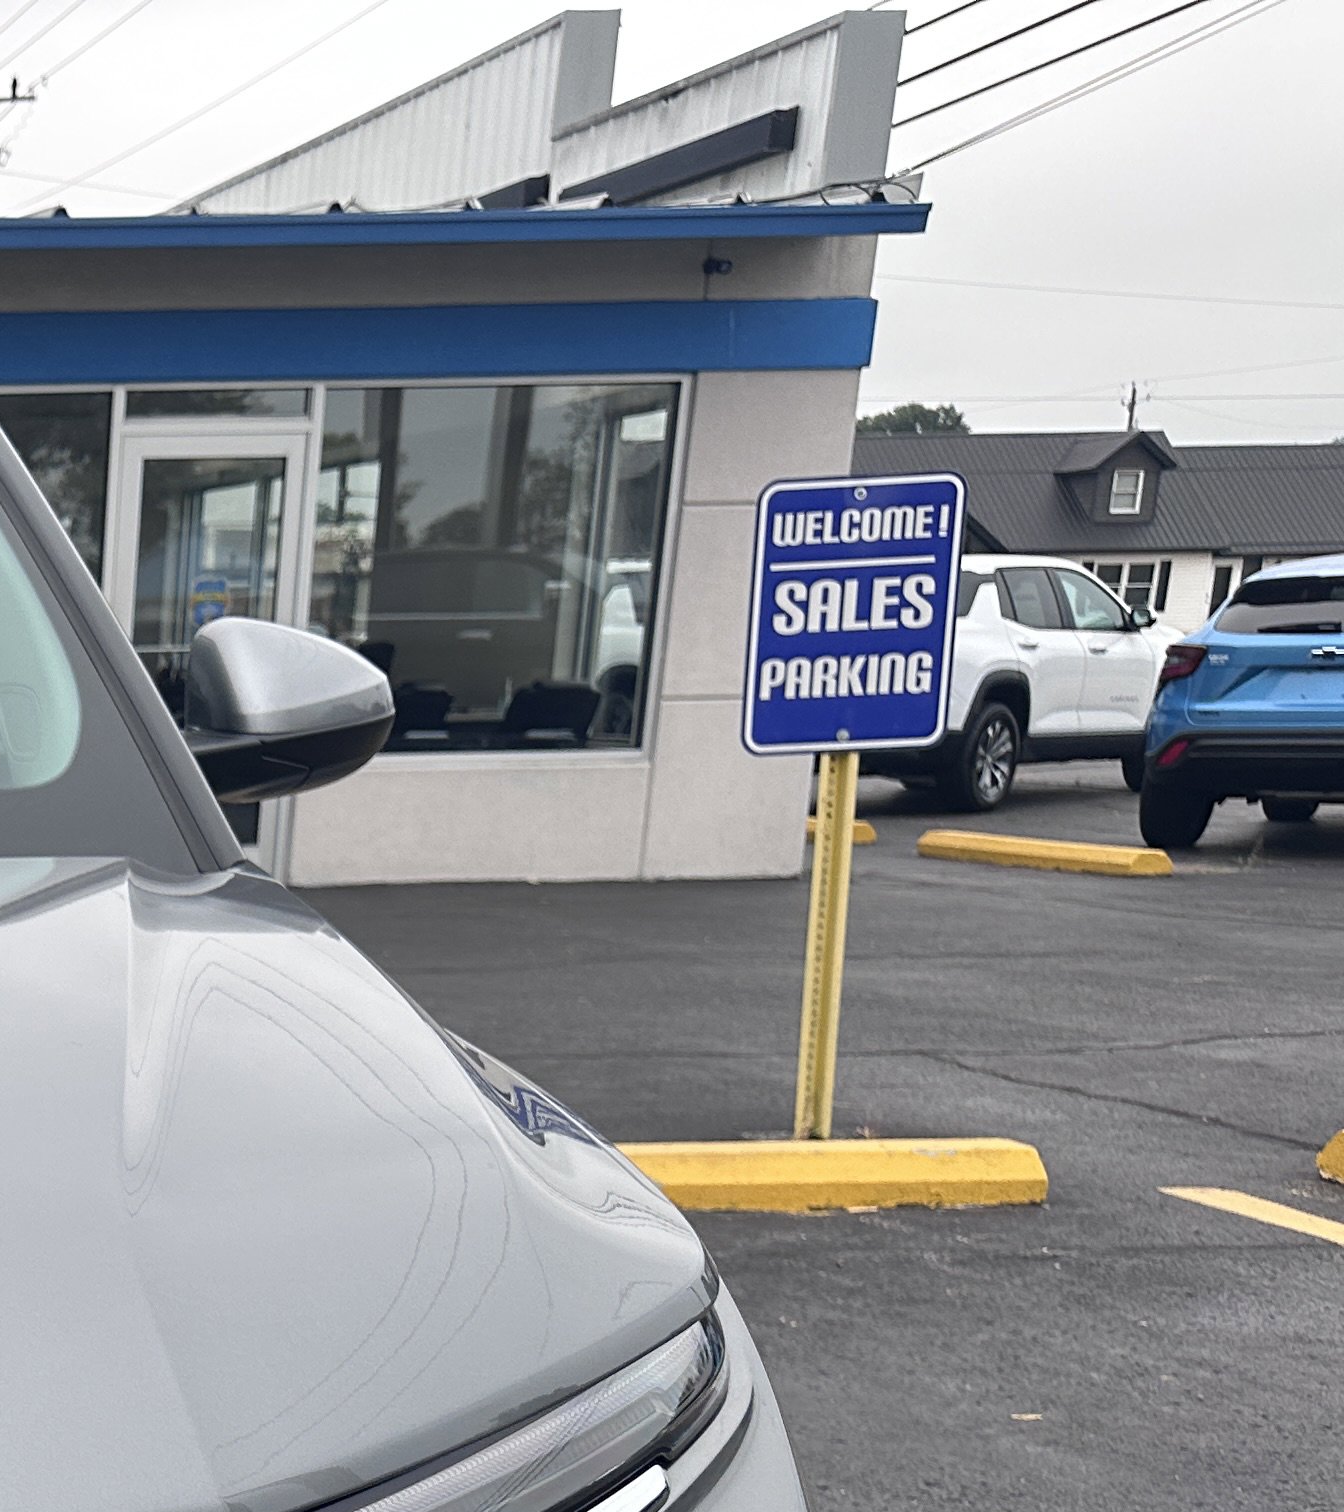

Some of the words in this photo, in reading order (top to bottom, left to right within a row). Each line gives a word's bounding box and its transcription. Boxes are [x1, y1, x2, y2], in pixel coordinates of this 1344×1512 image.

[772, 504, 950, 547] WELCOME!
[772, 573, 936, 636] SALES
[759, 651, 934, 701] PARKING
